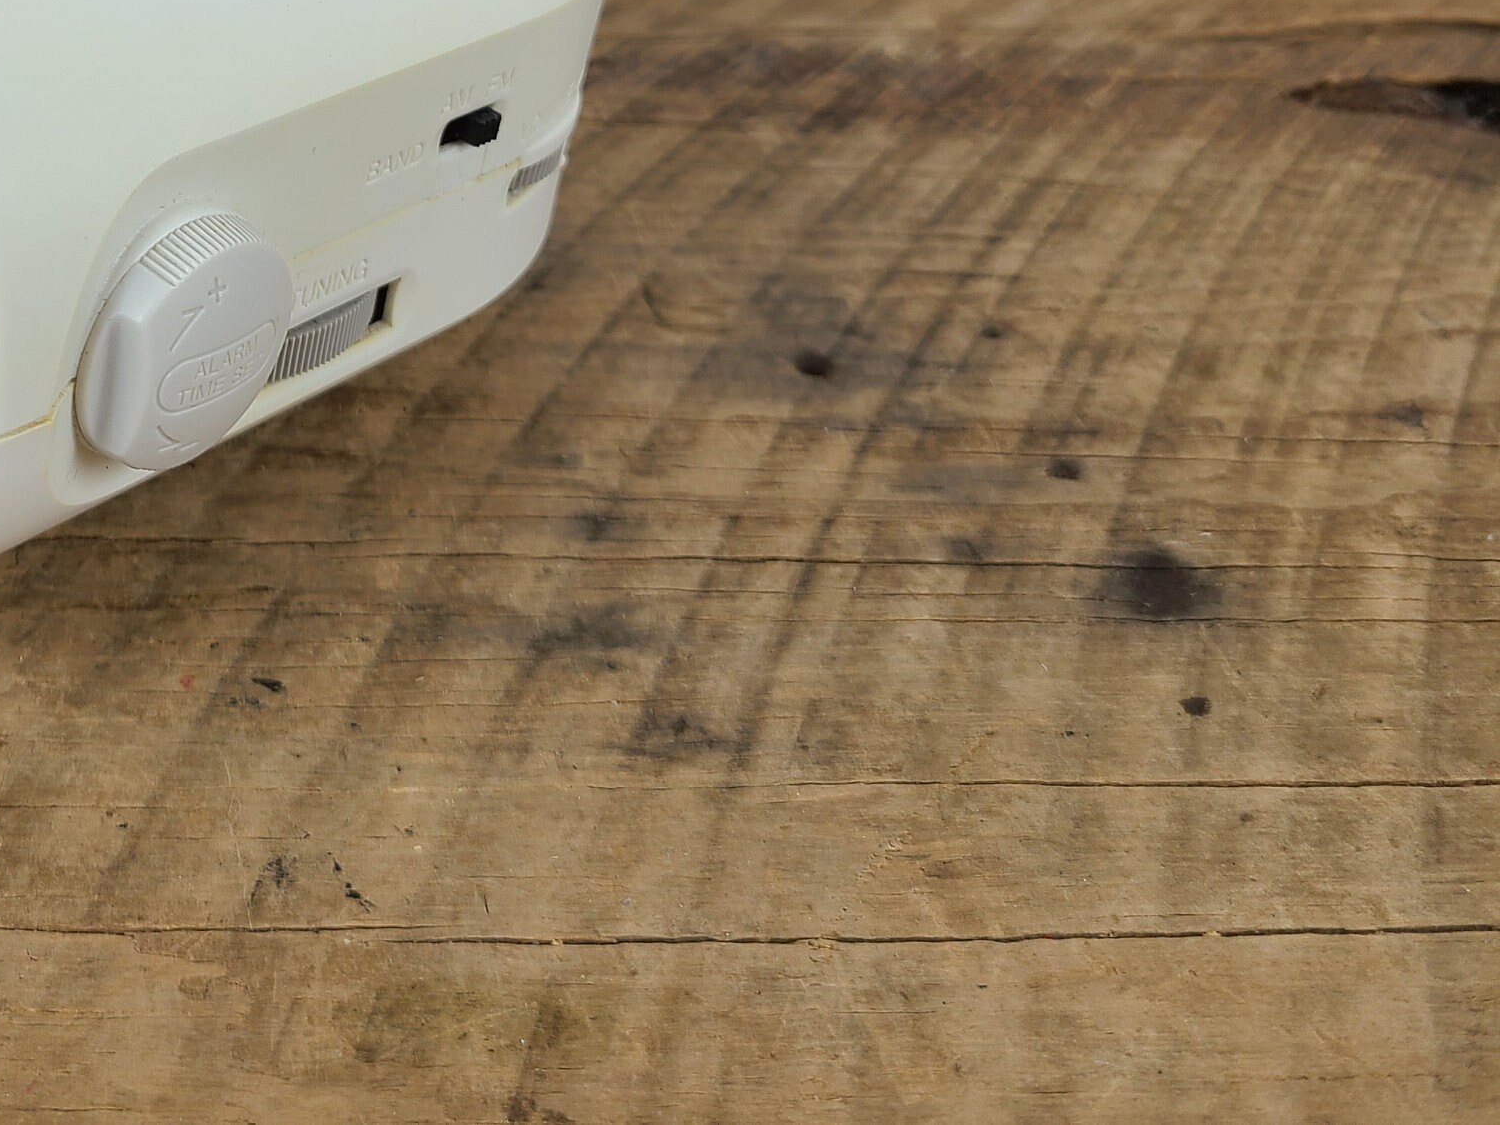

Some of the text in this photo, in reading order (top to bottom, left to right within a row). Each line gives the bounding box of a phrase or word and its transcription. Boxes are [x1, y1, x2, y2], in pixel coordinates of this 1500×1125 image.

[365, 142, 424, 186] BAND
[196, 333, 260, 379] ALARM
[177, 375, 227, 406] TIME
